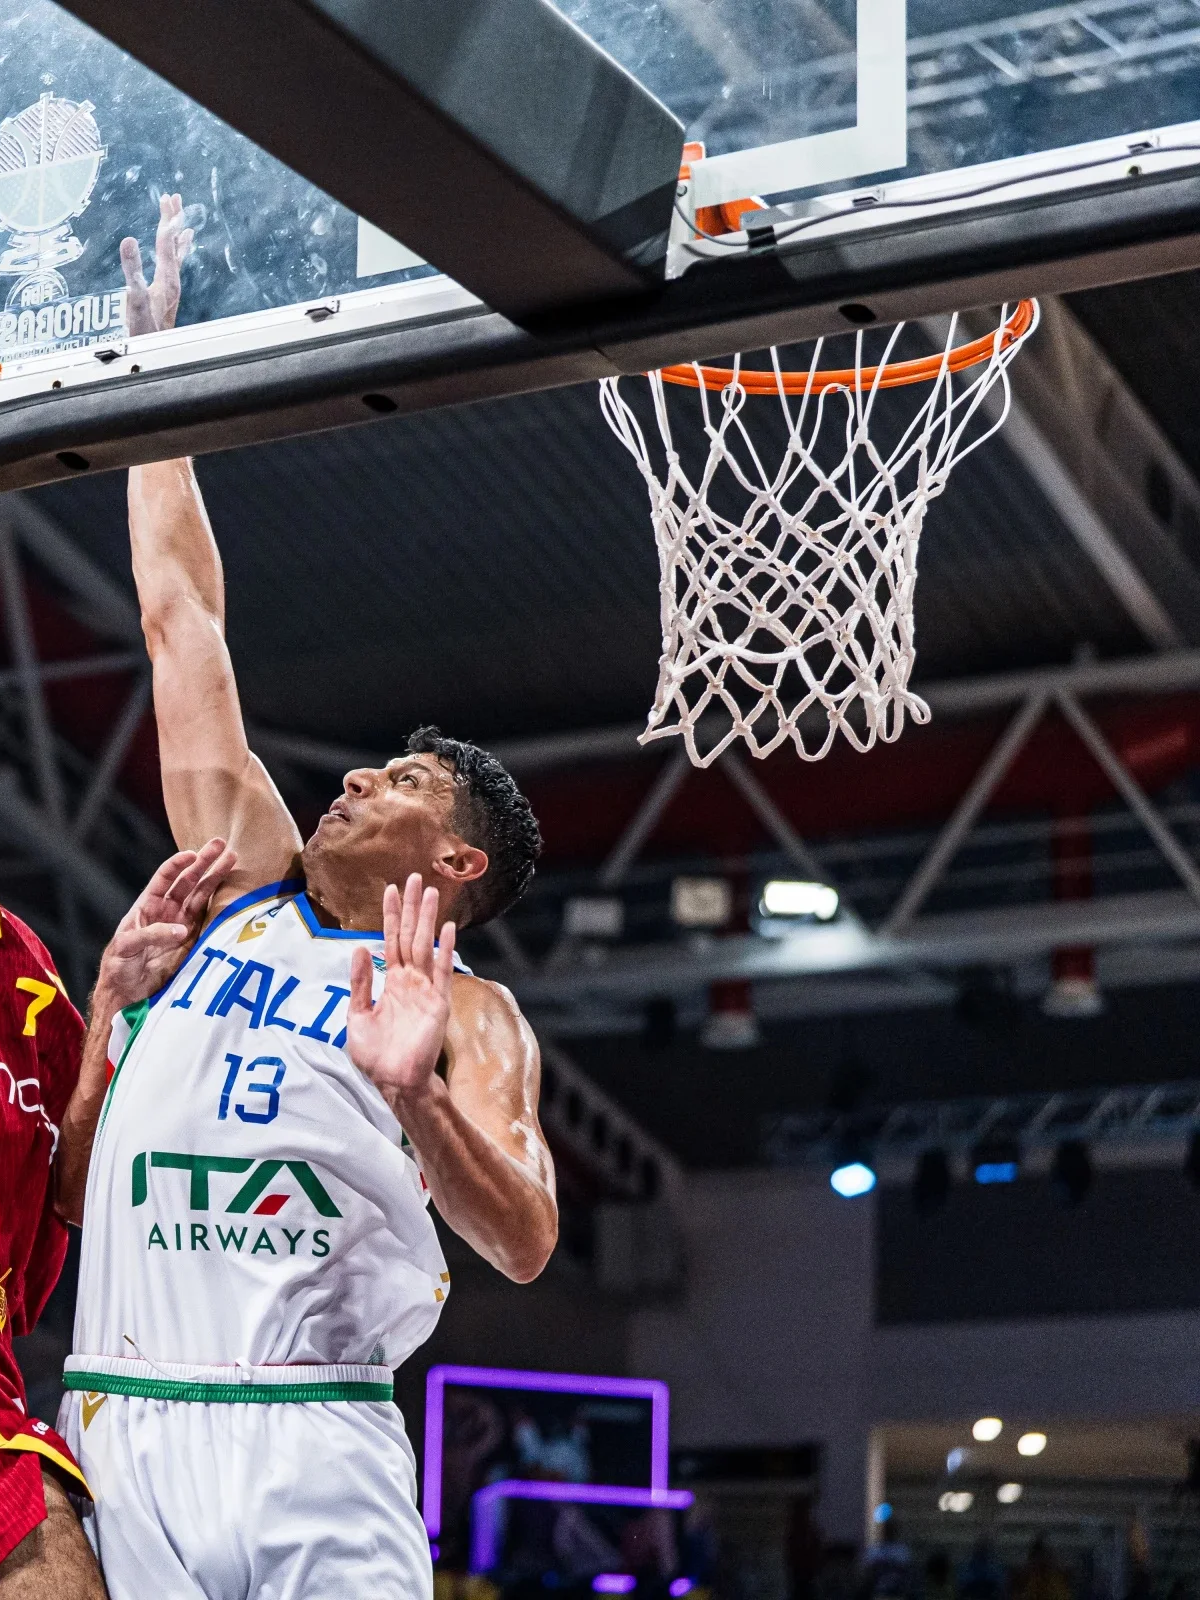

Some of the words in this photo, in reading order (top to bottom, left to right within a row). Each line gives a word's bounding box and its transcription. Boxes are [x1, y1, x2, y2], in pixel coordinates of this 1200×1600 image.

[15, 977, 57, 1036] 7
[217, 1053, 287, 1124] 13
[132, 1151, 343, 1218] ITA
[148, 1222, 331, 1257] AIRWAYS
